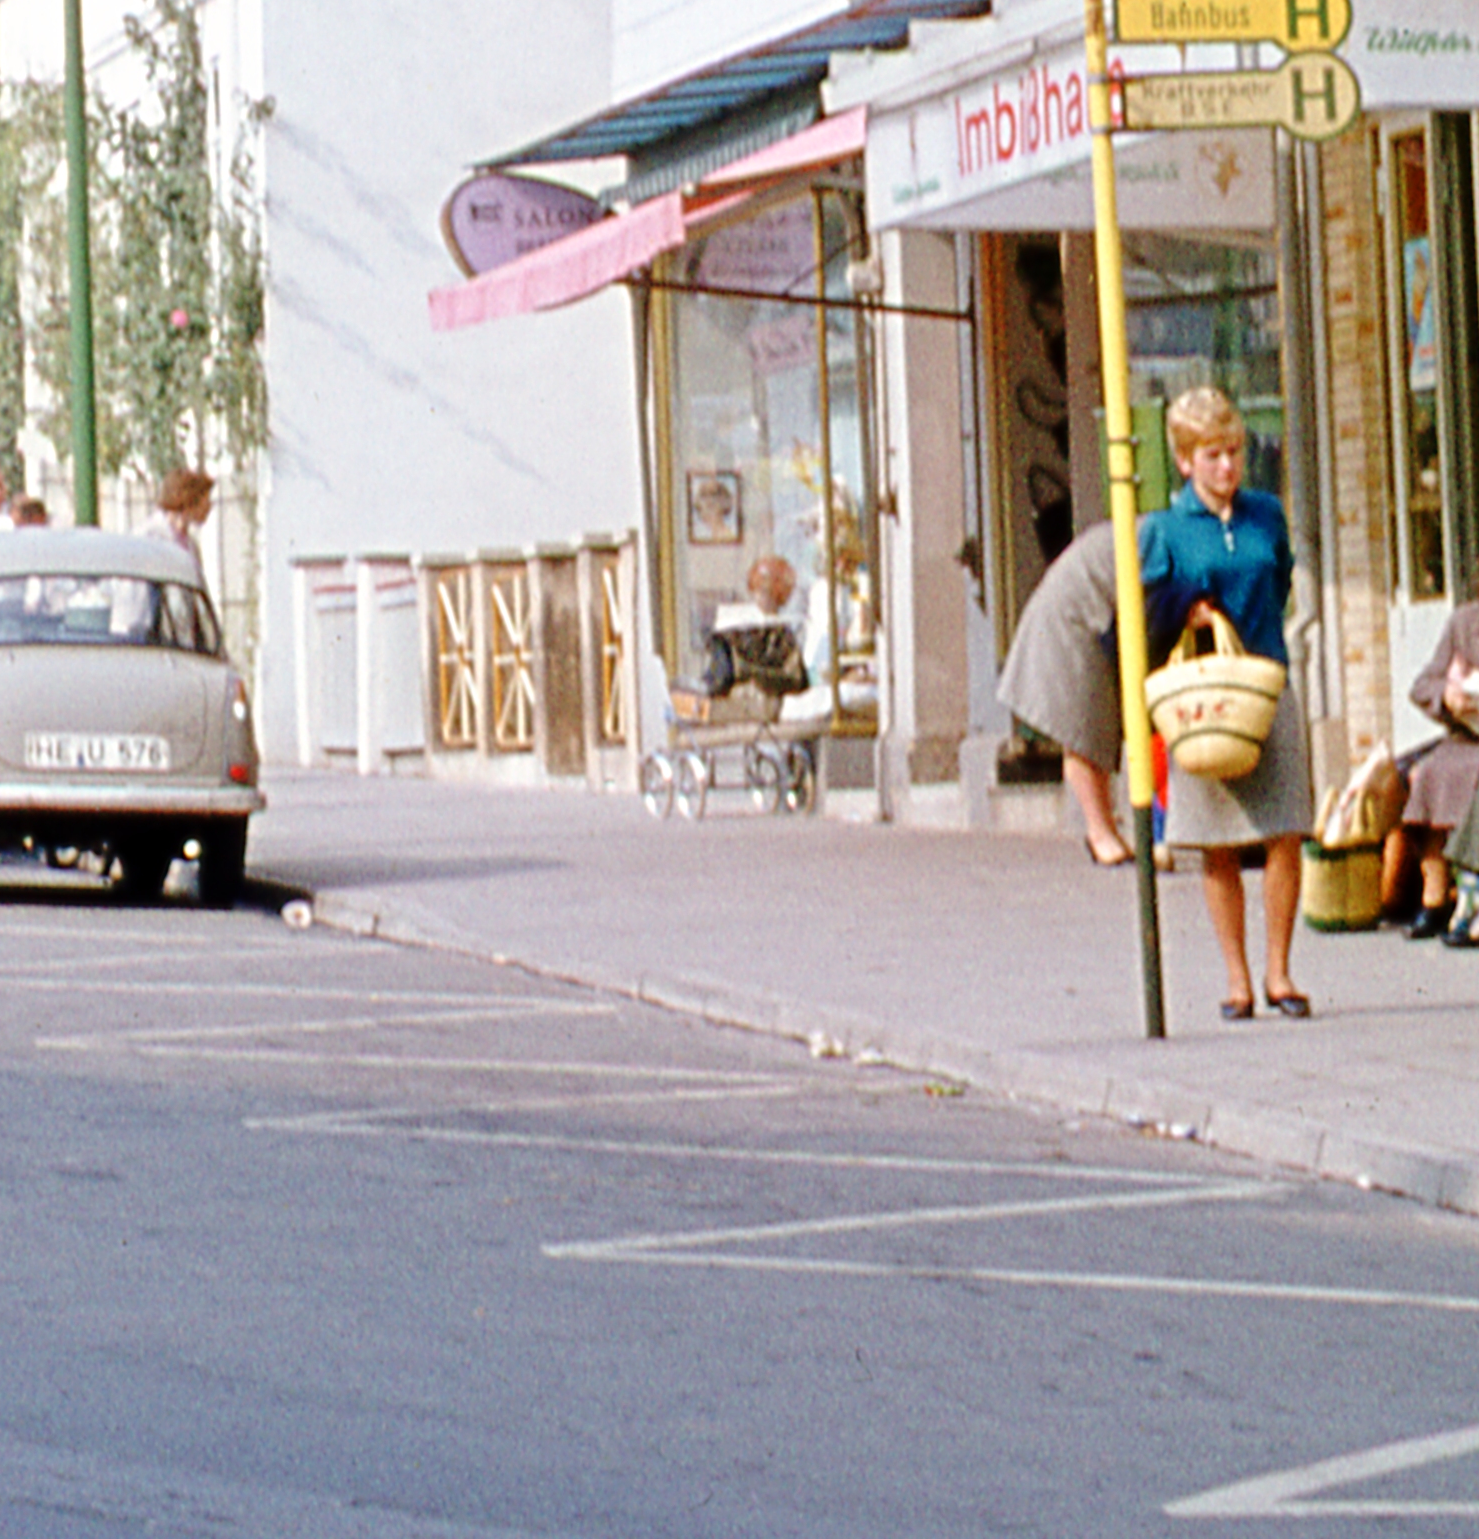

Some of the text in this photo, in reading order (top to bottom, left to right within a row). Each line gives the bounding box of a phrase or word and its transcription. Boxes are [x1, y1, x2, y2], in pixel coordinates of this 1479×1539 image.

[1150, 0, 1251, 30] Bahnbus
[1142, 66, 1337, 123] Kraftverkehr H
[514, 205, 597, 229] SALON
[87, 738, 106, 764] U
